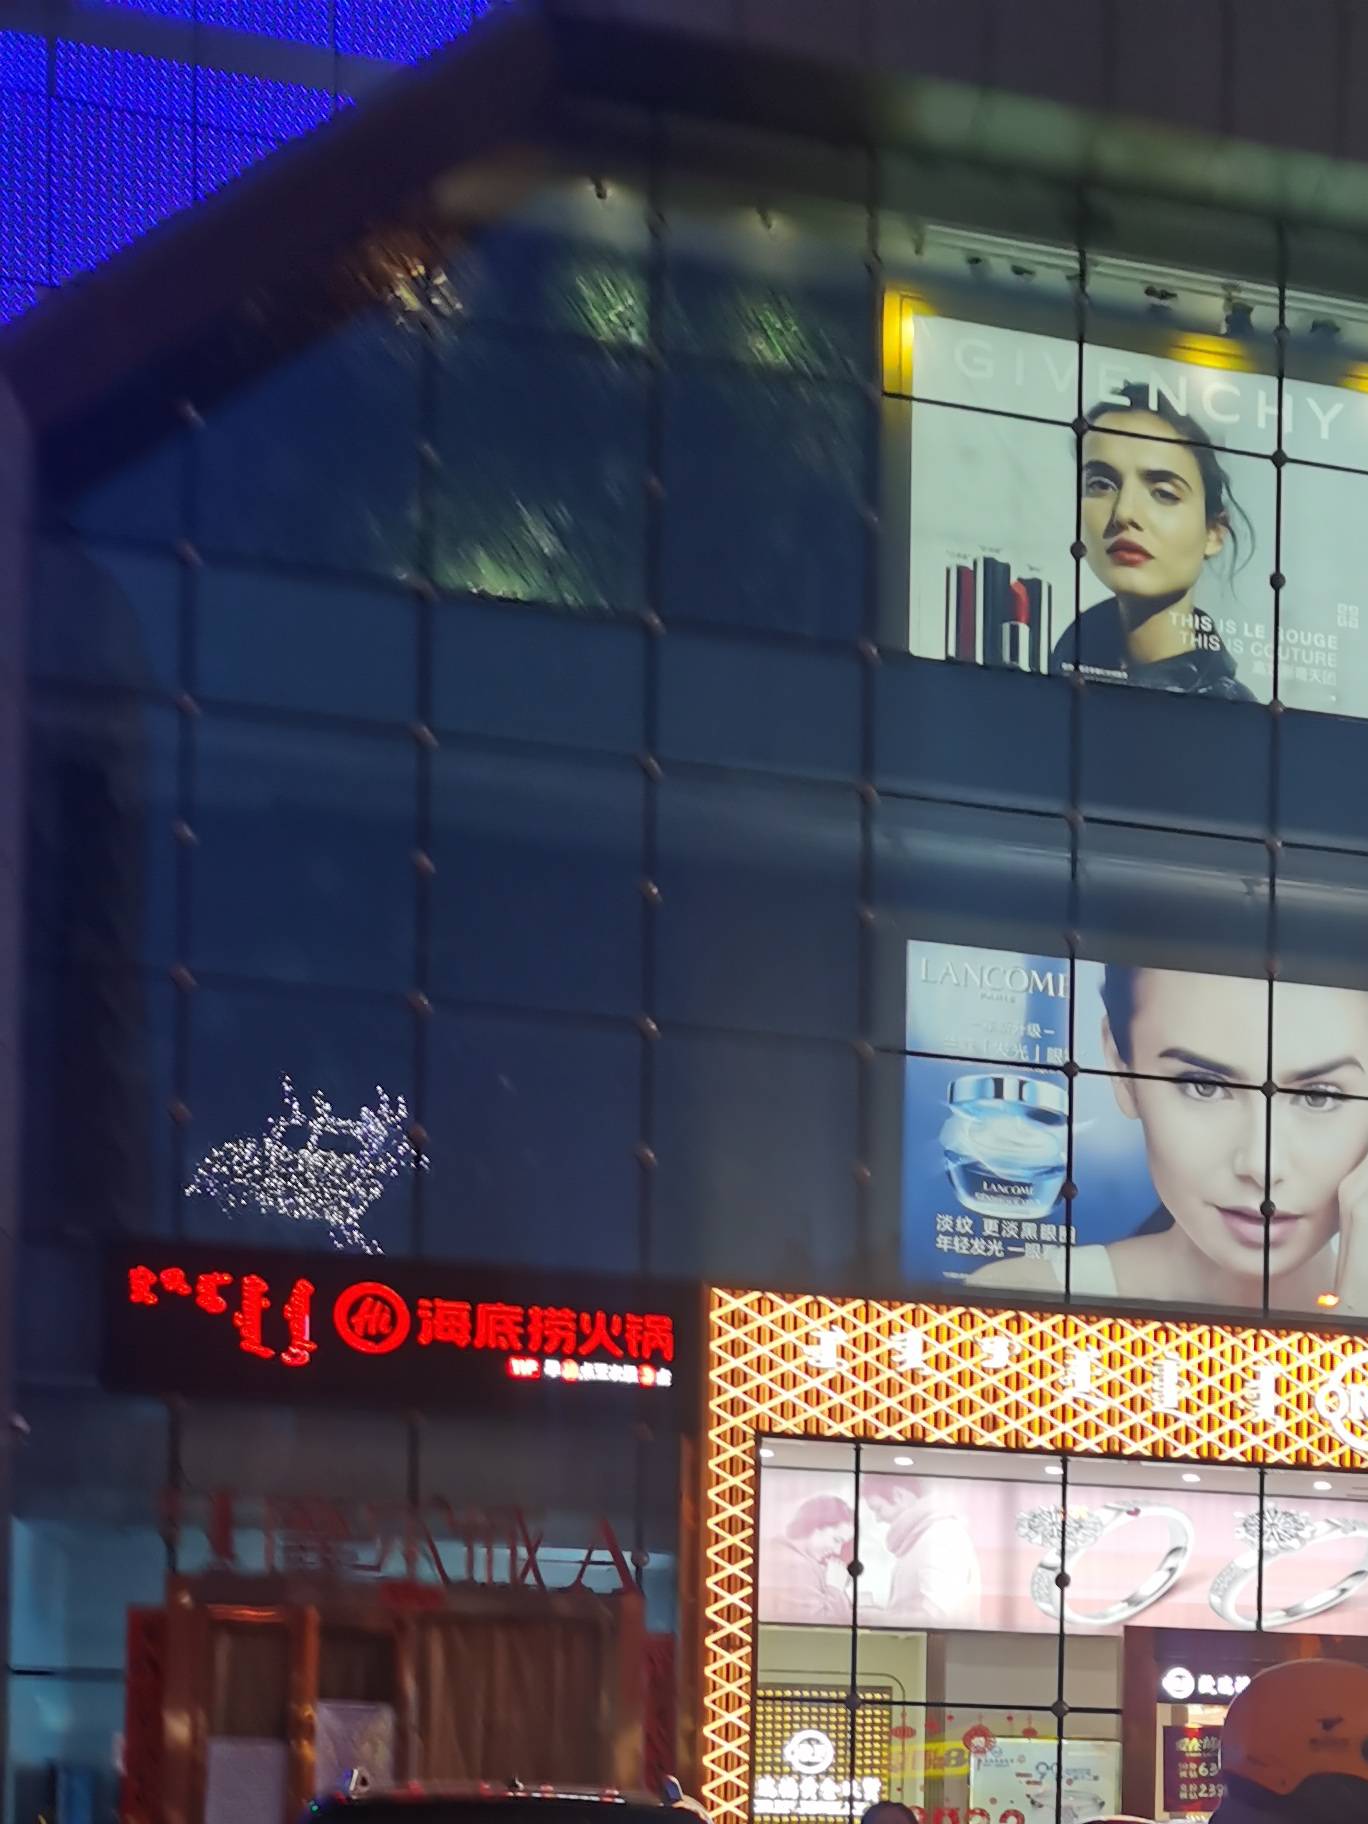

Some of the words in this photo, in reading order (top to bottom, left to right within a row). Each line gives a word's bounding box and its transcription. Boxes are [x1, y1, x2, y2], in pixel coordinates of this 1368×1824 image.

[954, 336, 1346, 441] GIVENCHY
[1169, 611, 1213, 632] THIS
[1219, 619, 1237, 634] IS
[1244, 623, 1266, 639] LE
[1180, 631, 1221, 651] THIS
[1226, 638, 1244, 654] IS
[936, 1213, 974, 1234] 淡纹
[416, 1297, 675, 1363] 海底捞火锅
